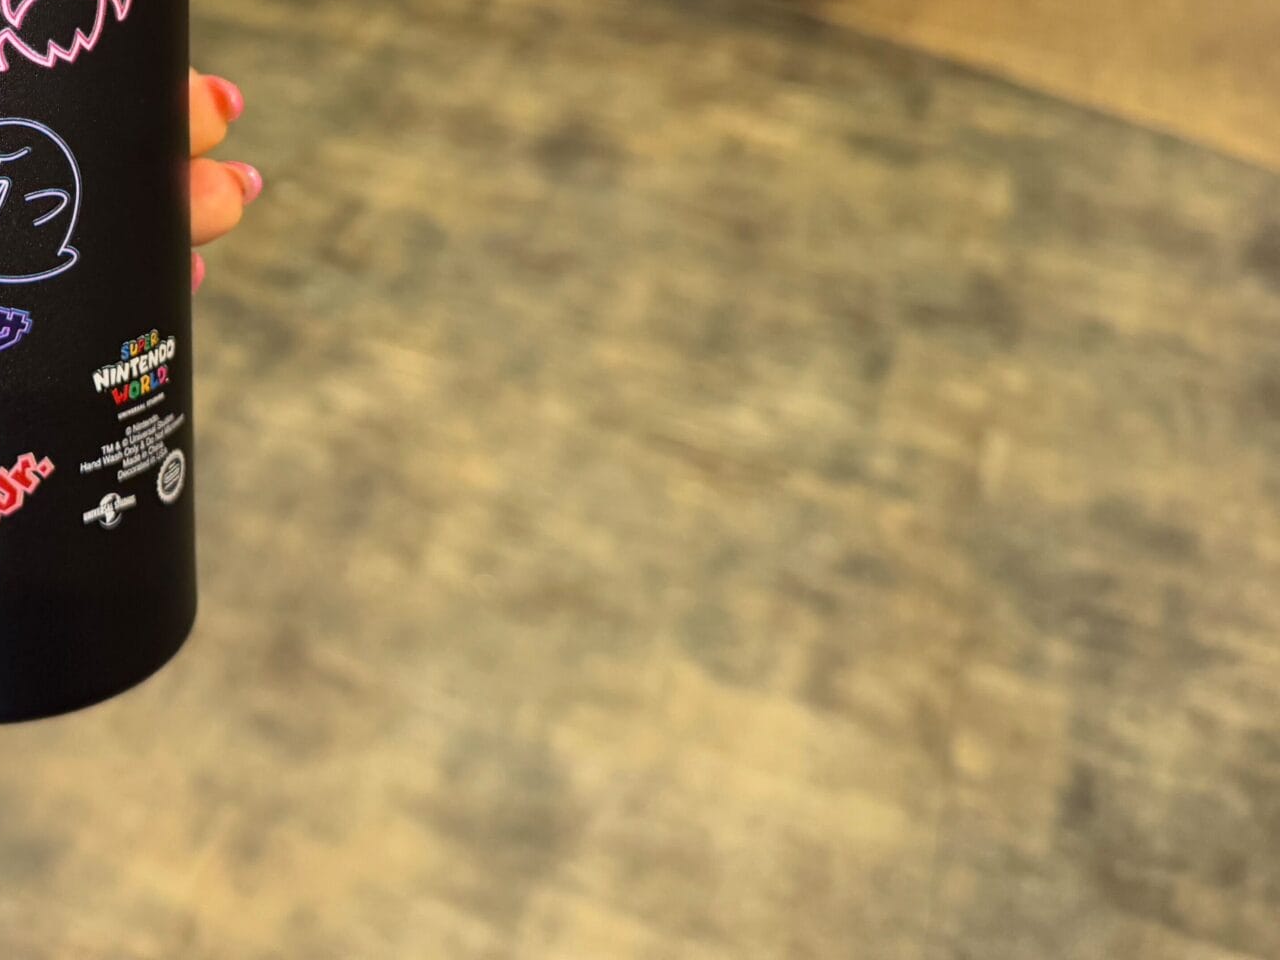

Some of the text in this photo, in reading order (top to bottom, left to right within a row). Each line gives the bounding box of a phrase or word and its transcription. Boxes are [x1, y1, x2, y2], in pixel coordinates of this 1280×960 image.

[121, 329, 159, 360] SUPER
[92, 337, 175, 392] NINTENDO
[80, 457, 102, 473] Hand
[103, 451, 123, 466] Wash
[124, 444, 139, 457] Only
[101, 443, 114, 454] TM
